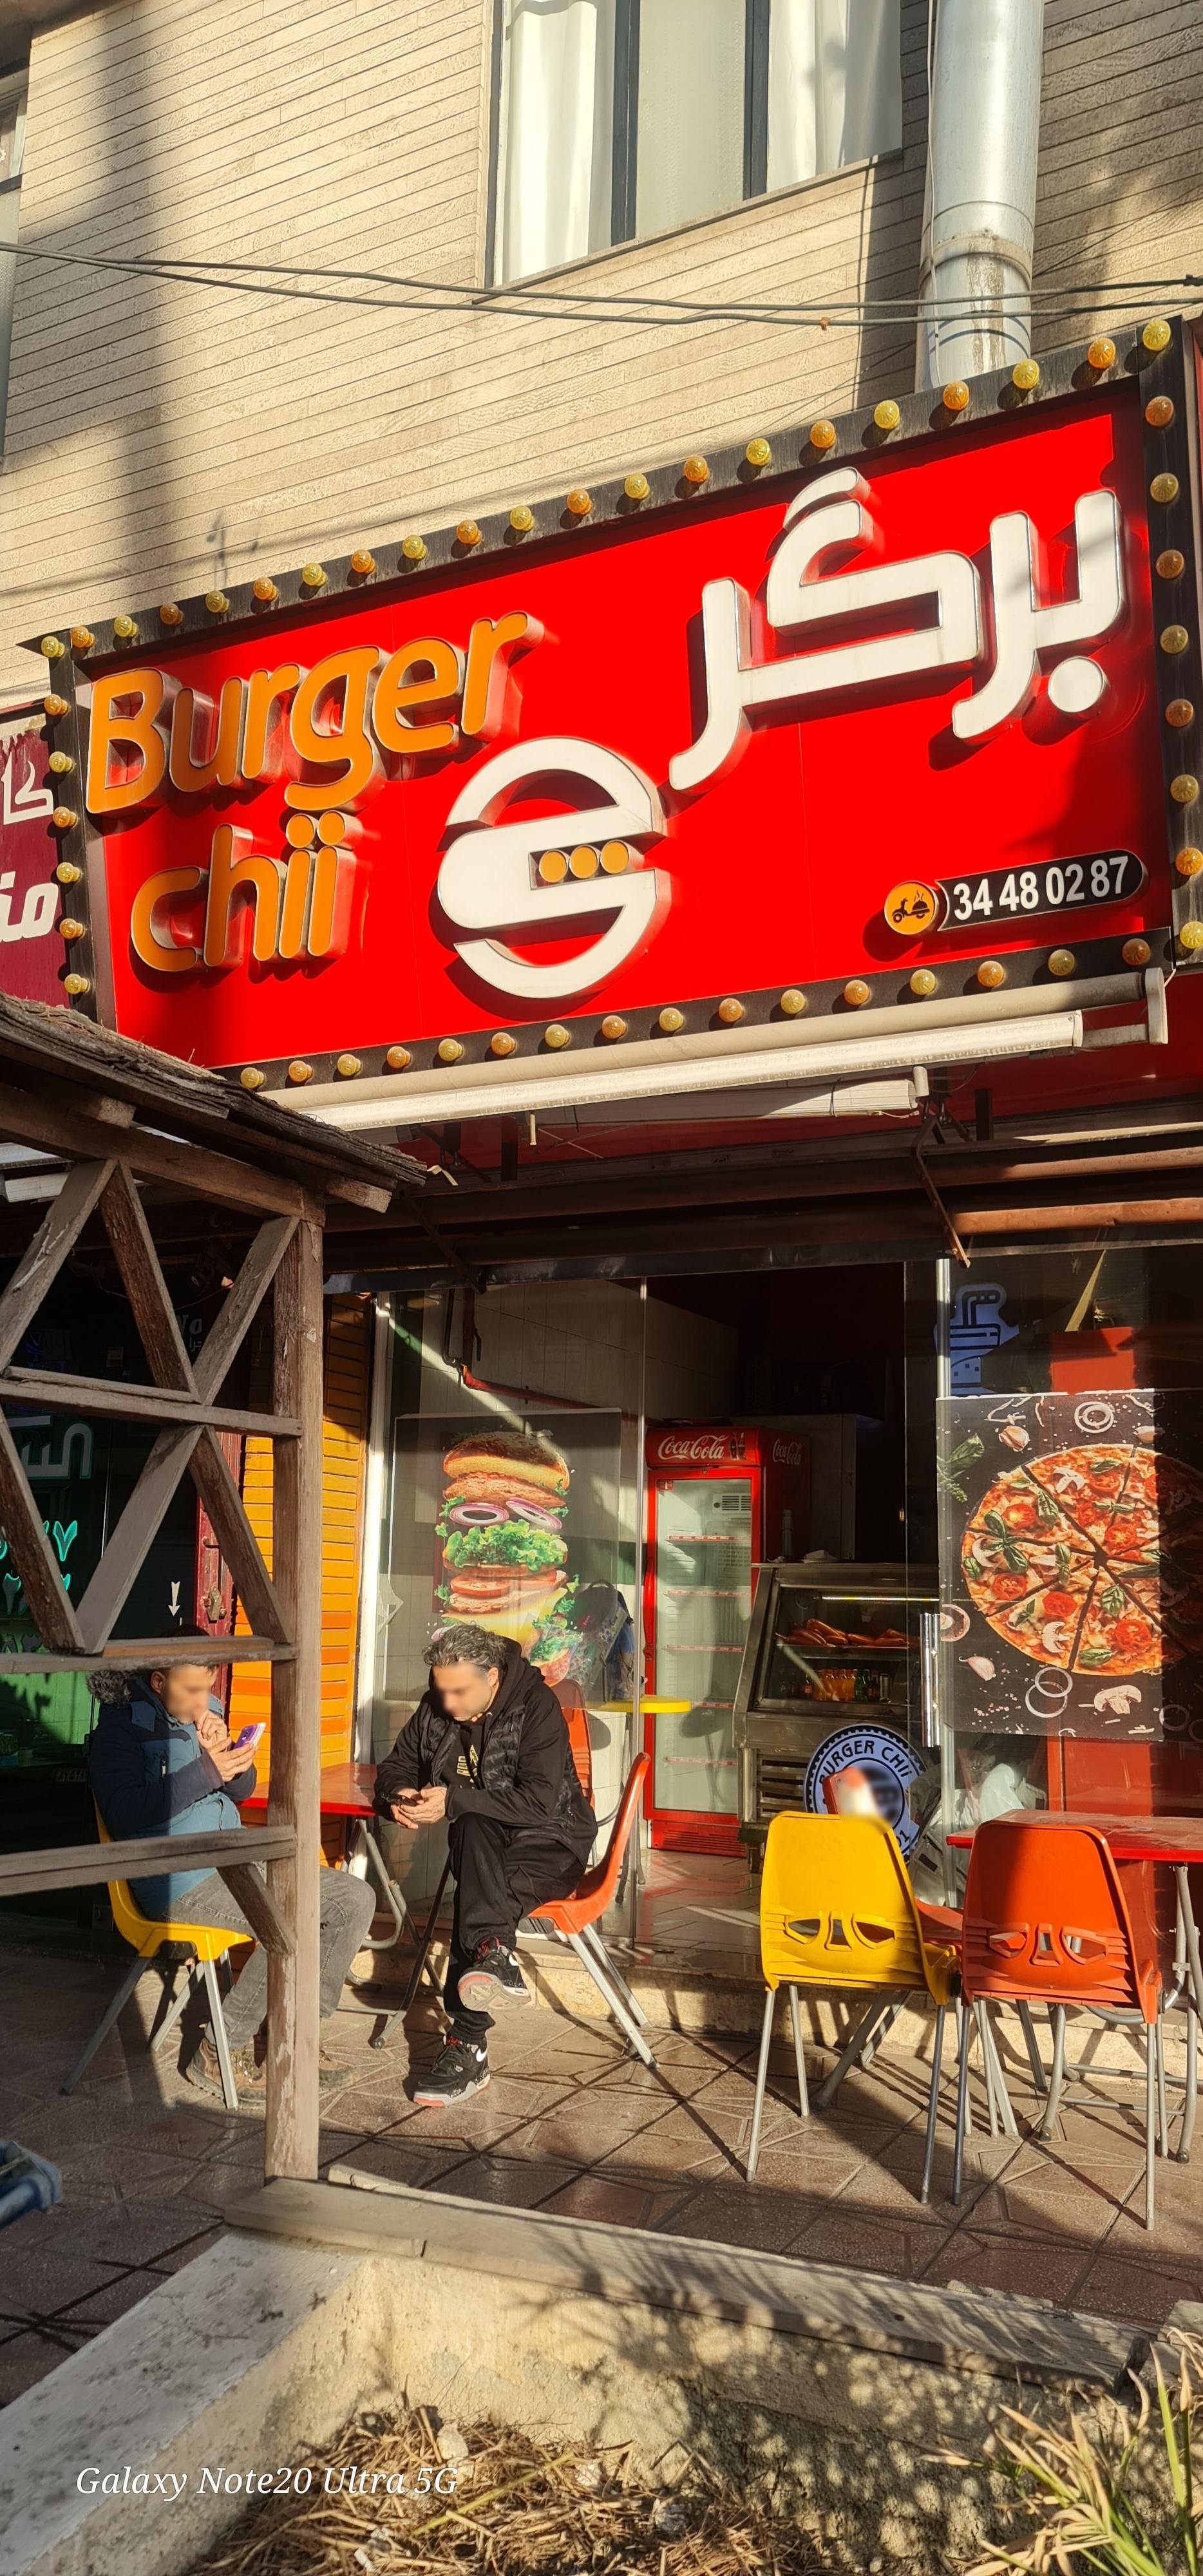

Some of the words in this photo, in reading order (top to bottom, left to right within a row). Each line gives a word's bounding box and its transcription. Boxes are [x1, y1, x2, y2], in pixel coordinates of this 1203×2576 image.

[669, 467, 1119, 791] برگر
[86, 611, 533, 813] Burger
[953, 878, 993, 920] 34
[999, 871, 1039, 912] 48
[1045, 864, 1085, 905] 02
[1090, 855, 1129, 898] 87
[658, 1435, 728, 1460] Coca-Cola
